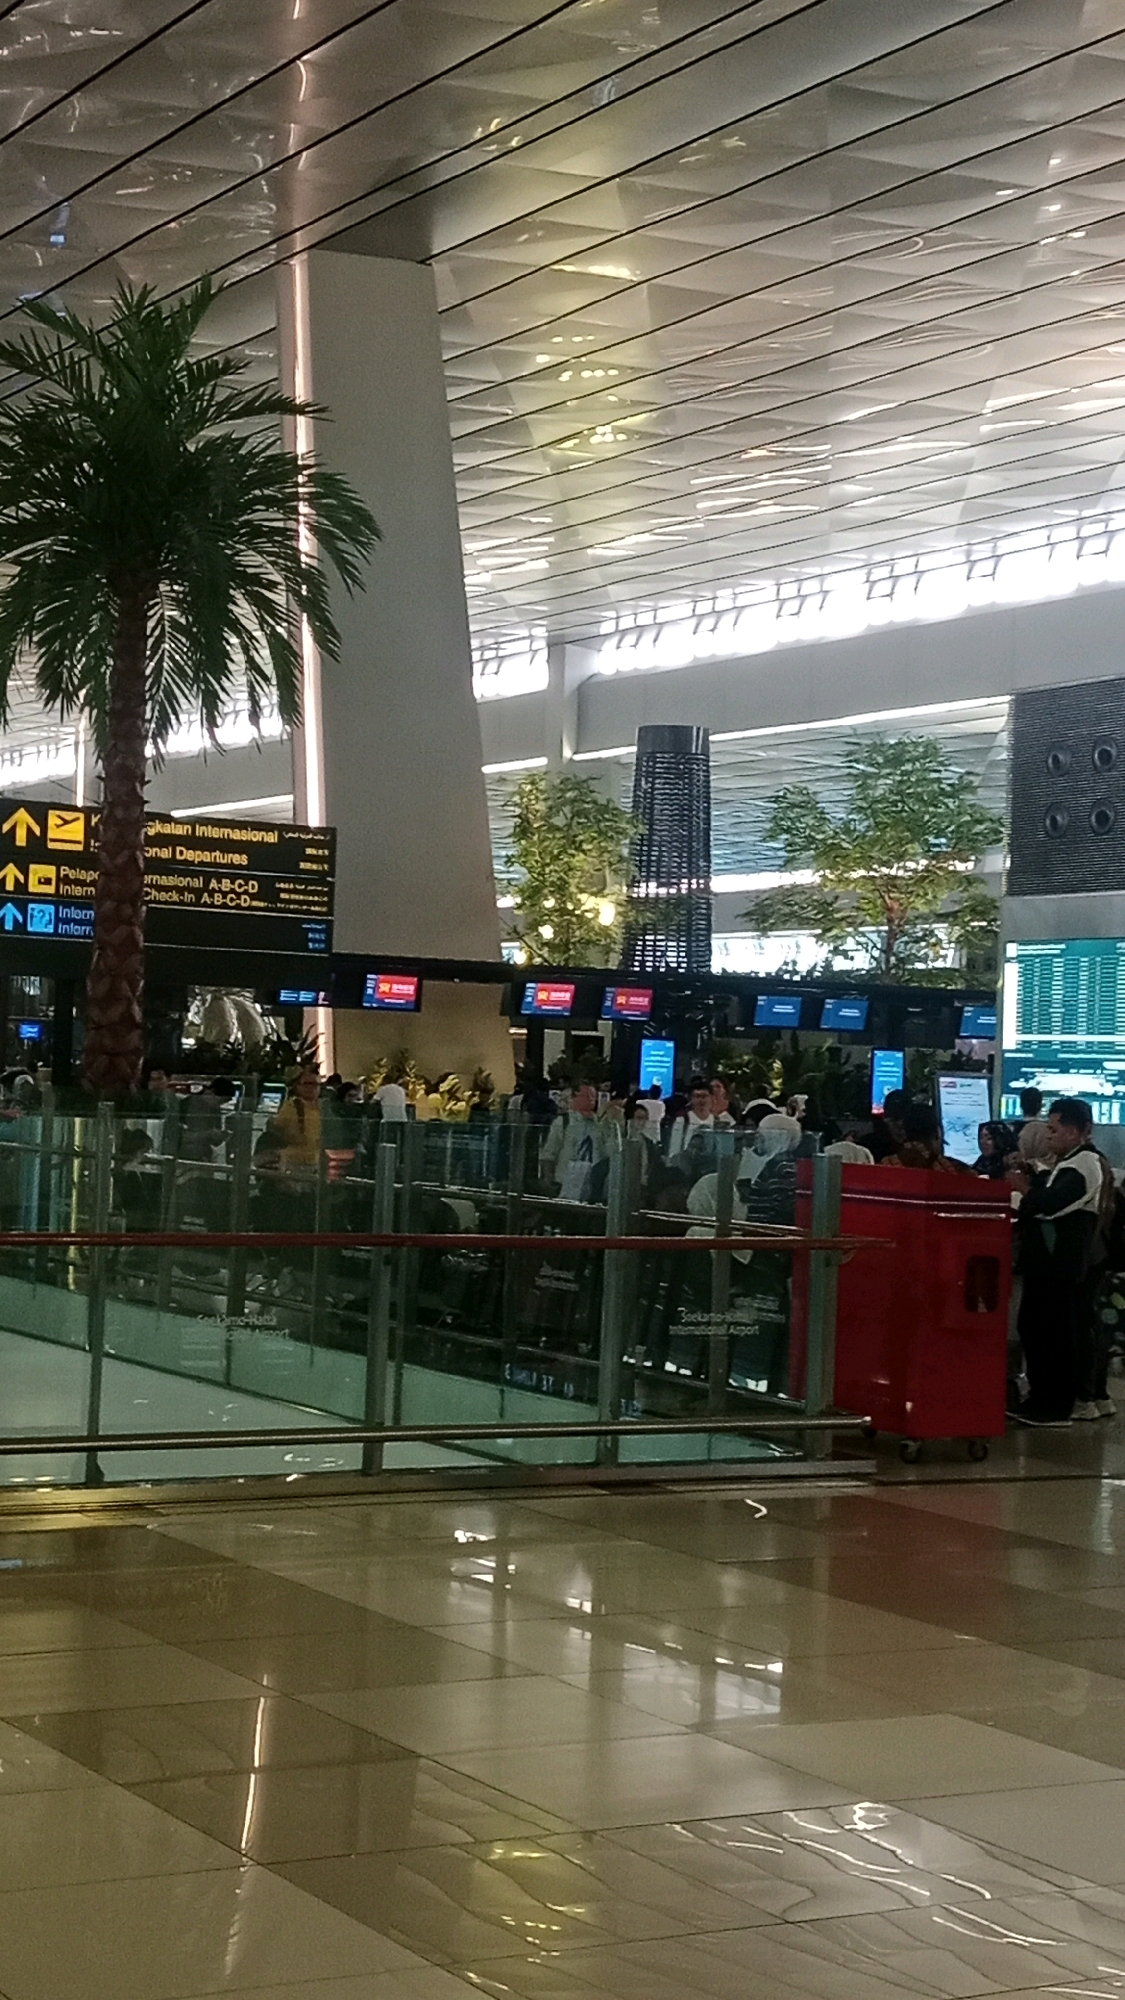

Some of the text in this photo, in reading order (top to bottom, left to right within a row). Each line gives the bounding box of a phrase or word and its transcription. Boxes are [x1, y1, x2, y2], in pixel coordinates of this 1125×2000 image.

[195, 822, 279, 843] Internasional
[175, 846, 249, 865] Departures
[209, 879, 259, 893] A-B-C-D
[200, 895, 252, 907] A-B-C-D
